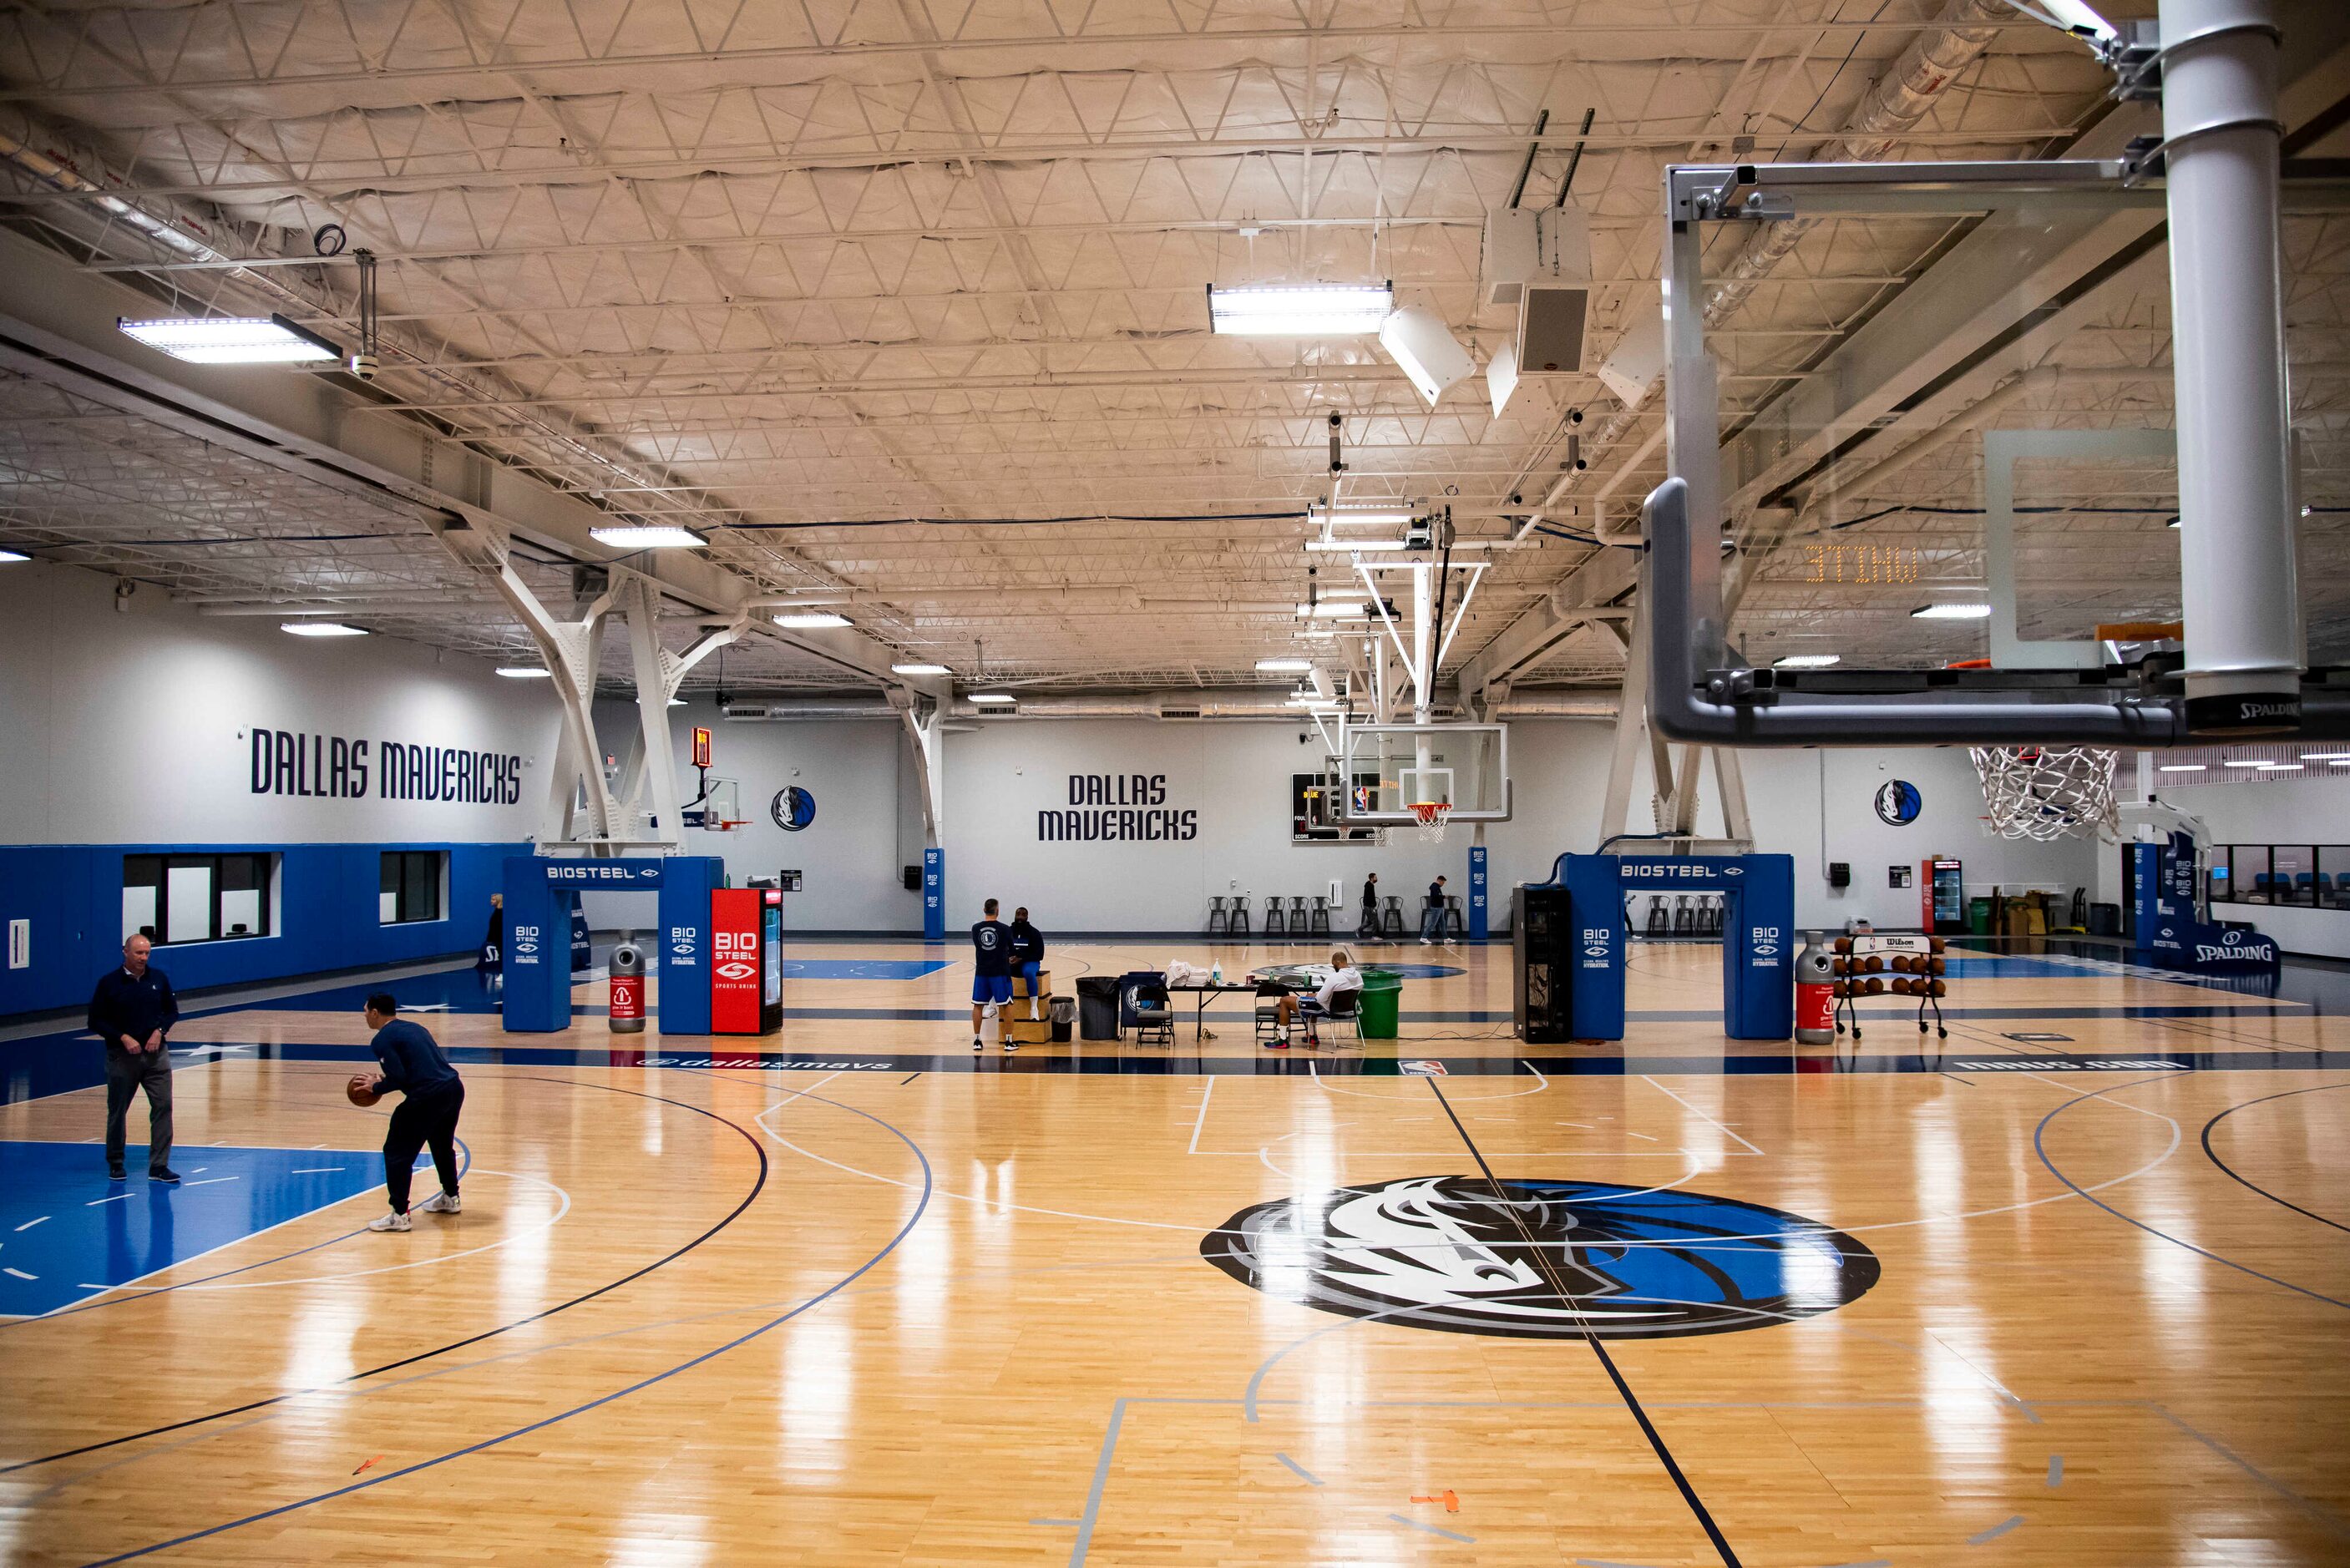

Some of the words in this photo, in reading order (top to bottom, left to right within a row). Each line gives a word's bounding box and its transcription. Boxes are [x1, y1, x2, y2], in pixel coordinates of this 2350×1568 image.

[251, 728, 368, 798] DALLAS
[381, 741, 521, 805] MAVERICKS
[1069, 775, 1166, 805] DALLAS
[1038, 810, 1198, 841] MAVERICKS
[547, 867, 636, 878] BIOSTEEL
[1621, 865, 1718, 877] BIOSTEEL
[515, 926, 539, 936] BIO
[671, 927, 696, 938] BIO
[1583, 928, 1609, 939] BIO
[1752, 927, 1779, 938] BIO
[715, 933, 756, 950] BIO
[1887, 938, 1914, 946] Wilson
[2153, 939, 2182, 949] BIOSTEEL
[715, 951, 756, 960] STEEL
[2196, 943, 2273, 962] SPALDING
[636, 1057, 894, 1070] @dallasmavs
